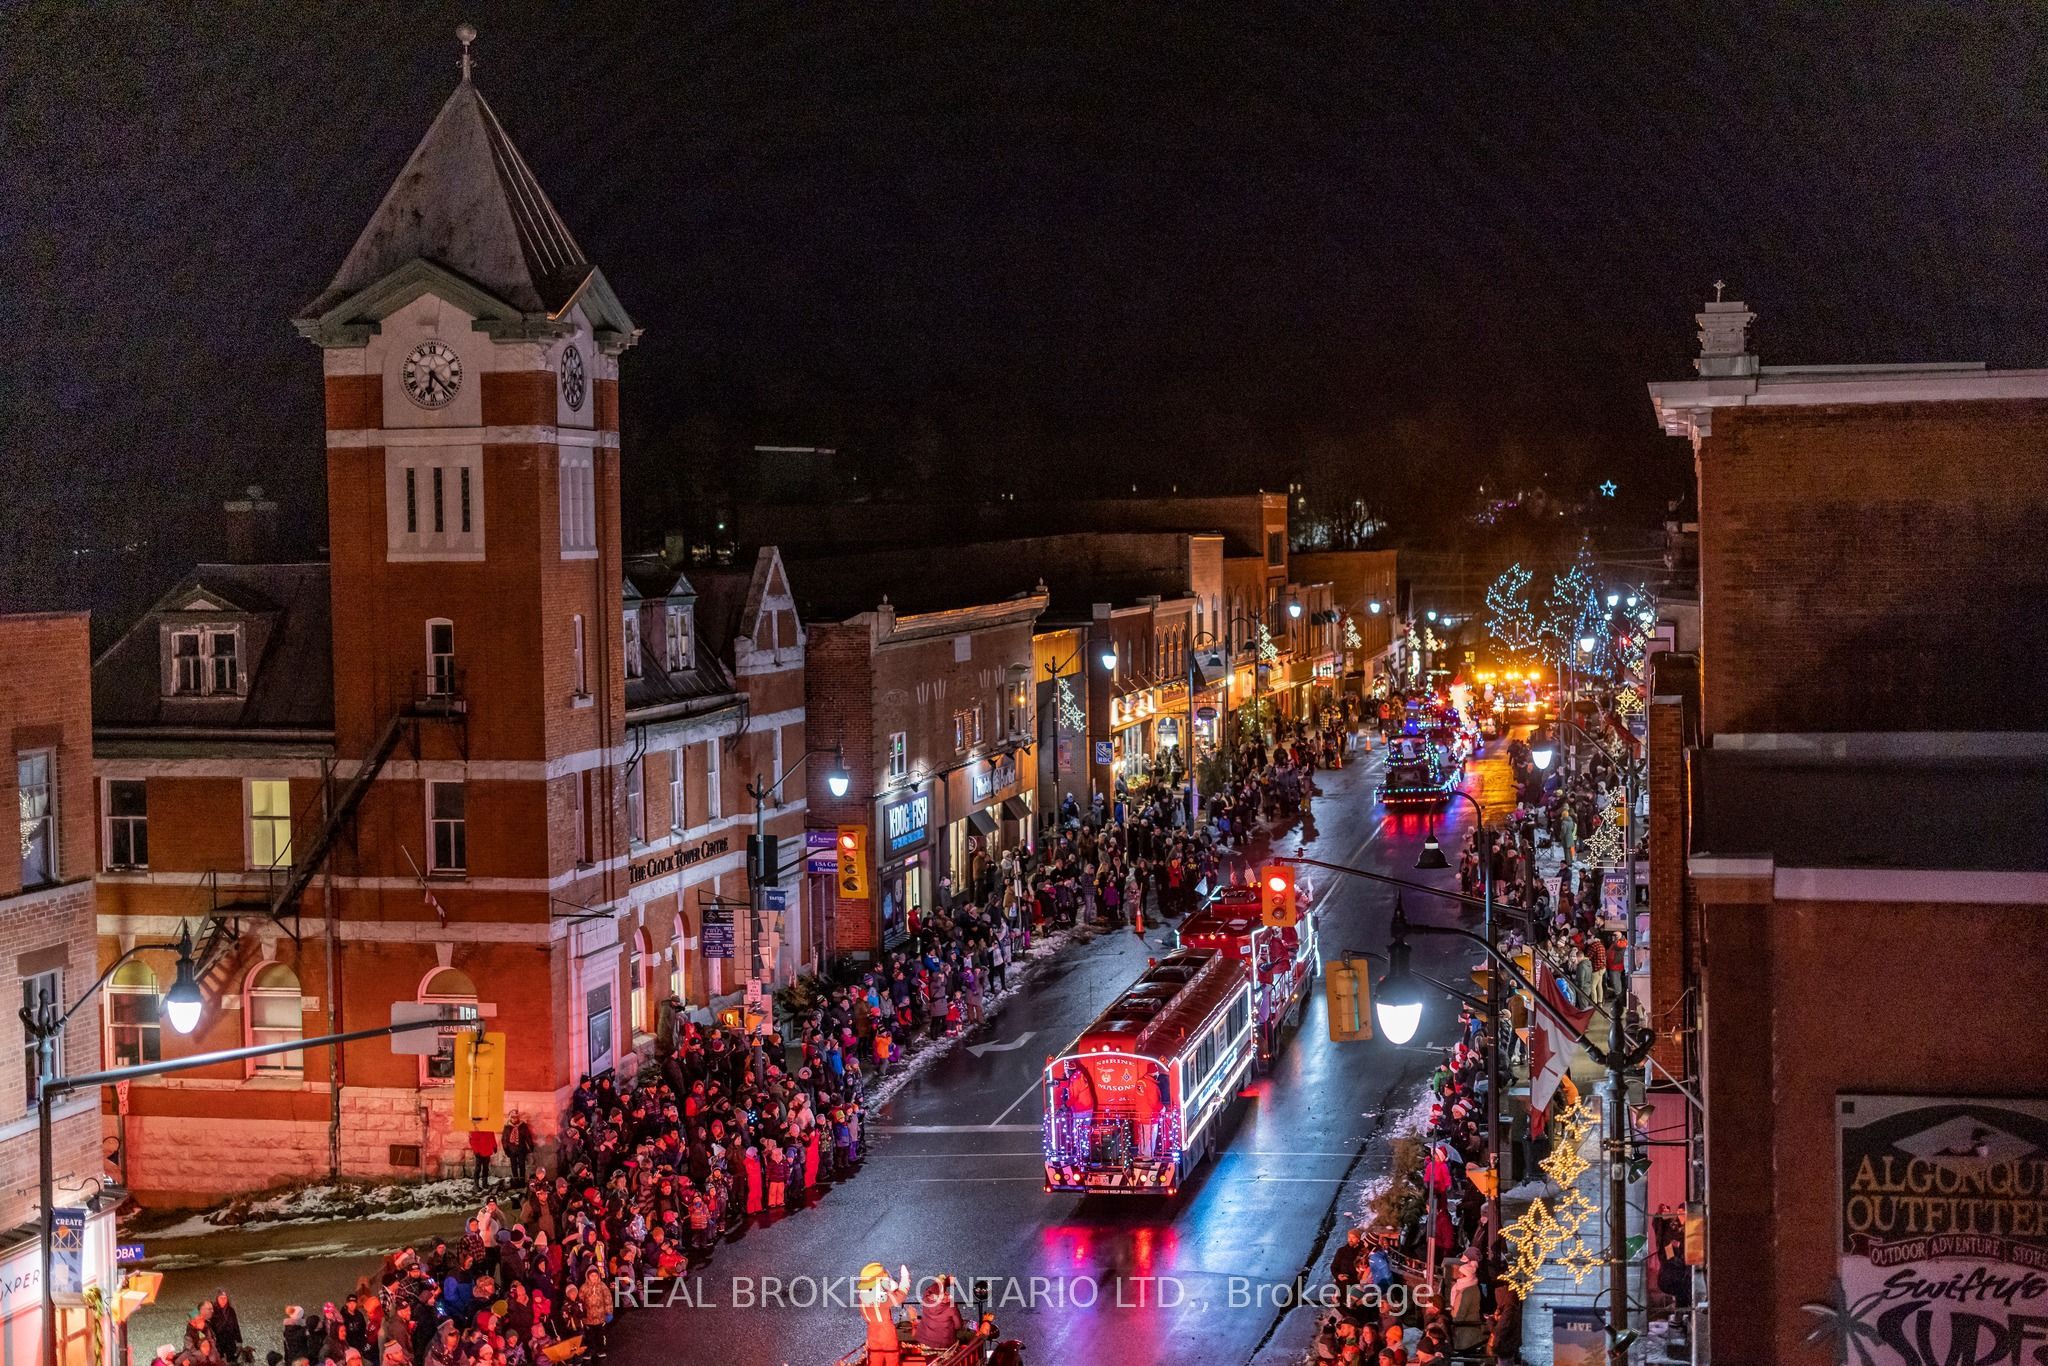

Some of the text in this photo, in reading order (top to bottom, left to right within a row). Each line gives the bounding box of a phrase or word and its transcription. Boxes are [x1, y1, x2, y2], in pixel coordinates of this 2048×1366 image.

[912, 796, 928, 829] FISH
[1097, 1083, 1136, 1091] MASONS
[55, 1218, 83, 1226] CREATE
[1871, 1242, 1926, 1264] OUTDOOR
[1931, 1237, 2000, 1255] ADVENTURE
[1881, 1267, 2047, 1307] Swifty's
[1567, 1322, 1592, 1331] LIVE
